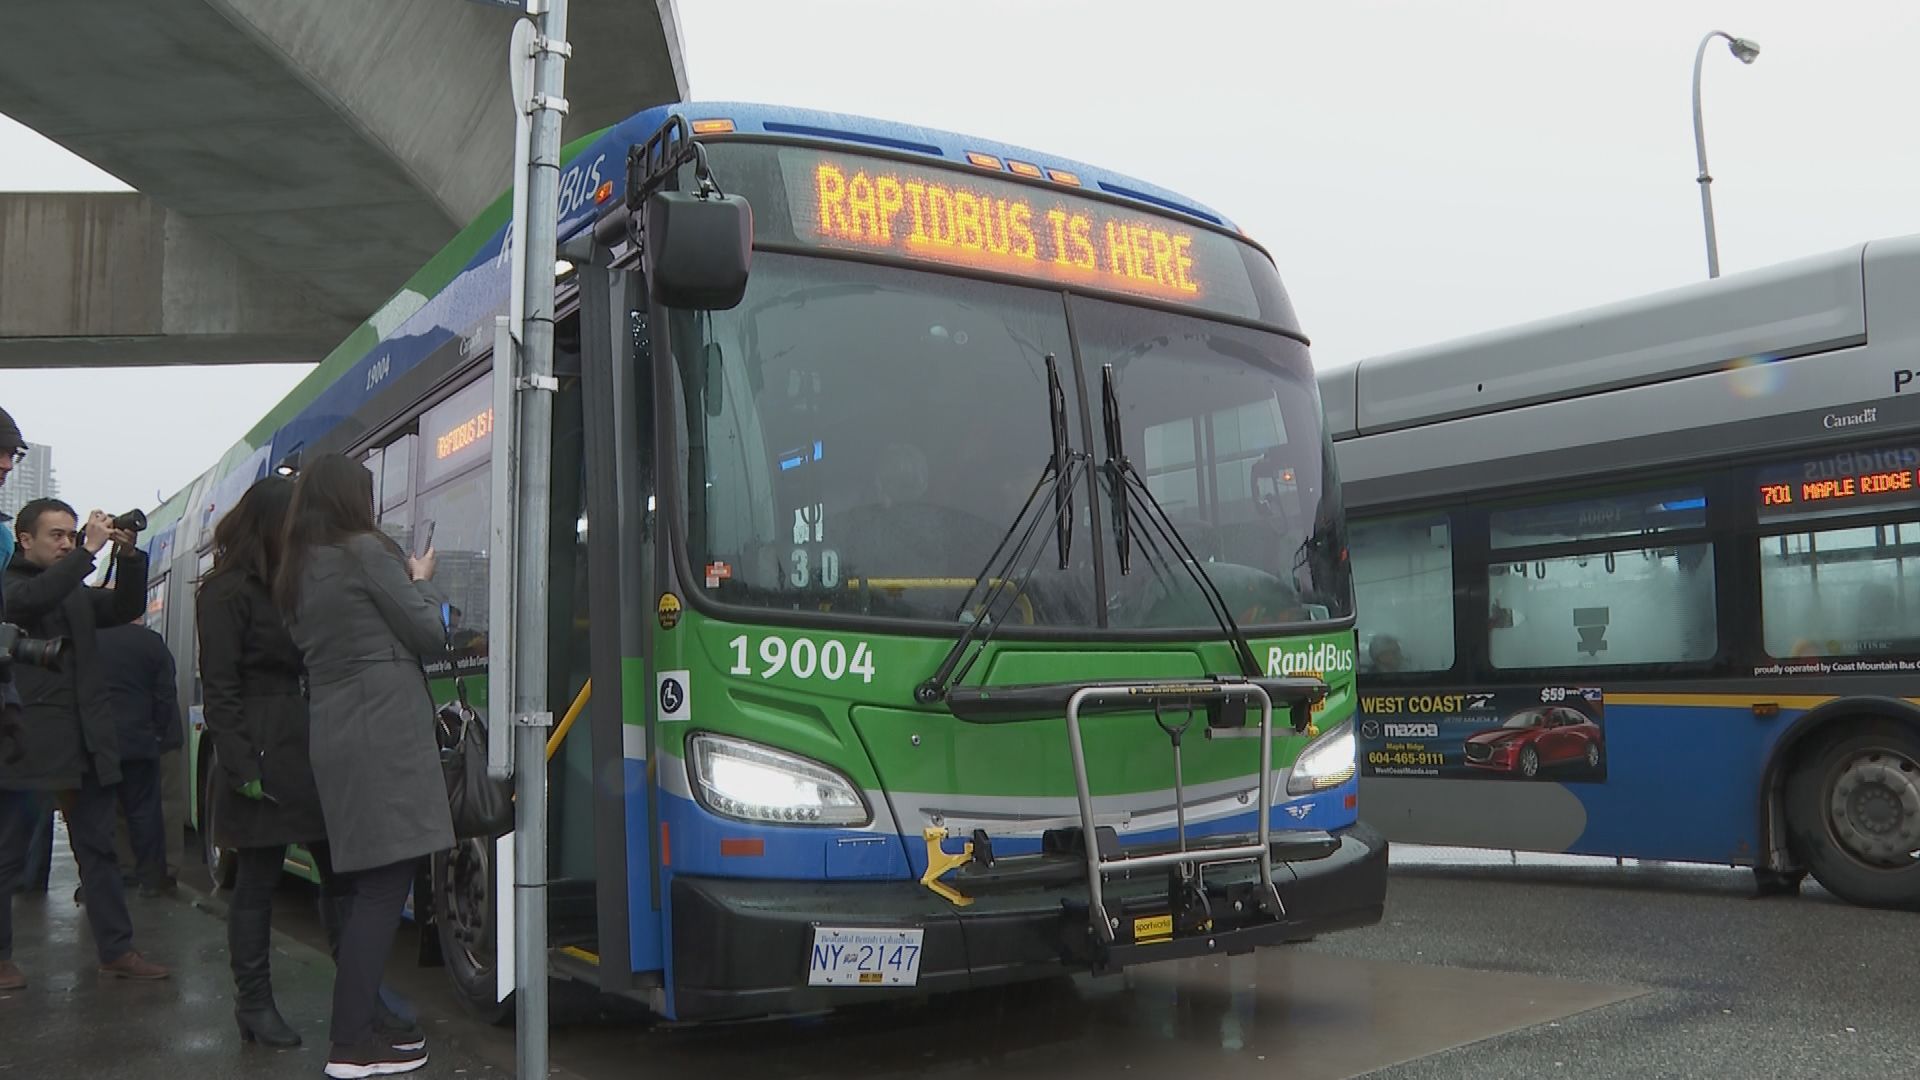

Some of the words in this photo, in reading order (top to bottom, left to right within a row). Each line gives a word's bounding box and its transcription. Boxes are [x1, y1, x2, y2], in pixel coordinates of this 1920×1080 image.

[815, 162, 1037, 260] RAPIDBUS
[1046, 206, 1096, 269] IS
[1104, 219, 1199, 293] HERE
[1894, 369, 1920, 393] P
[1824, 408, 1877, 429] Canada
[1760, 485, 1793, 505] 701
[1802, 478, 1855, 501] MAPLE
[1860, 470, 1912, 494] RIDGE
[729, 634, 876, 683] 19004
[1267, 642, 1353, 677] RapidBus
[1754, 665, 1784, 676] proudly
[1784, 663, 1820, 675] operated
[1821, 662, 1831, 673] by
[1833, 661, 1855, 671] Coast
[1856, 660, 1898, 671] Mountain
[1899, 660, 1915, 670] Bus
[1361, 696, 1405, 713] WEST
[1408, 695, 1465, 713] COAST
[1540, 687, 1566, 702] $59
[1369, 751, 1444, 765] 604-465-9111
[812, 944, 844, 971] NY
[858, 944, 919, 971] 2147
